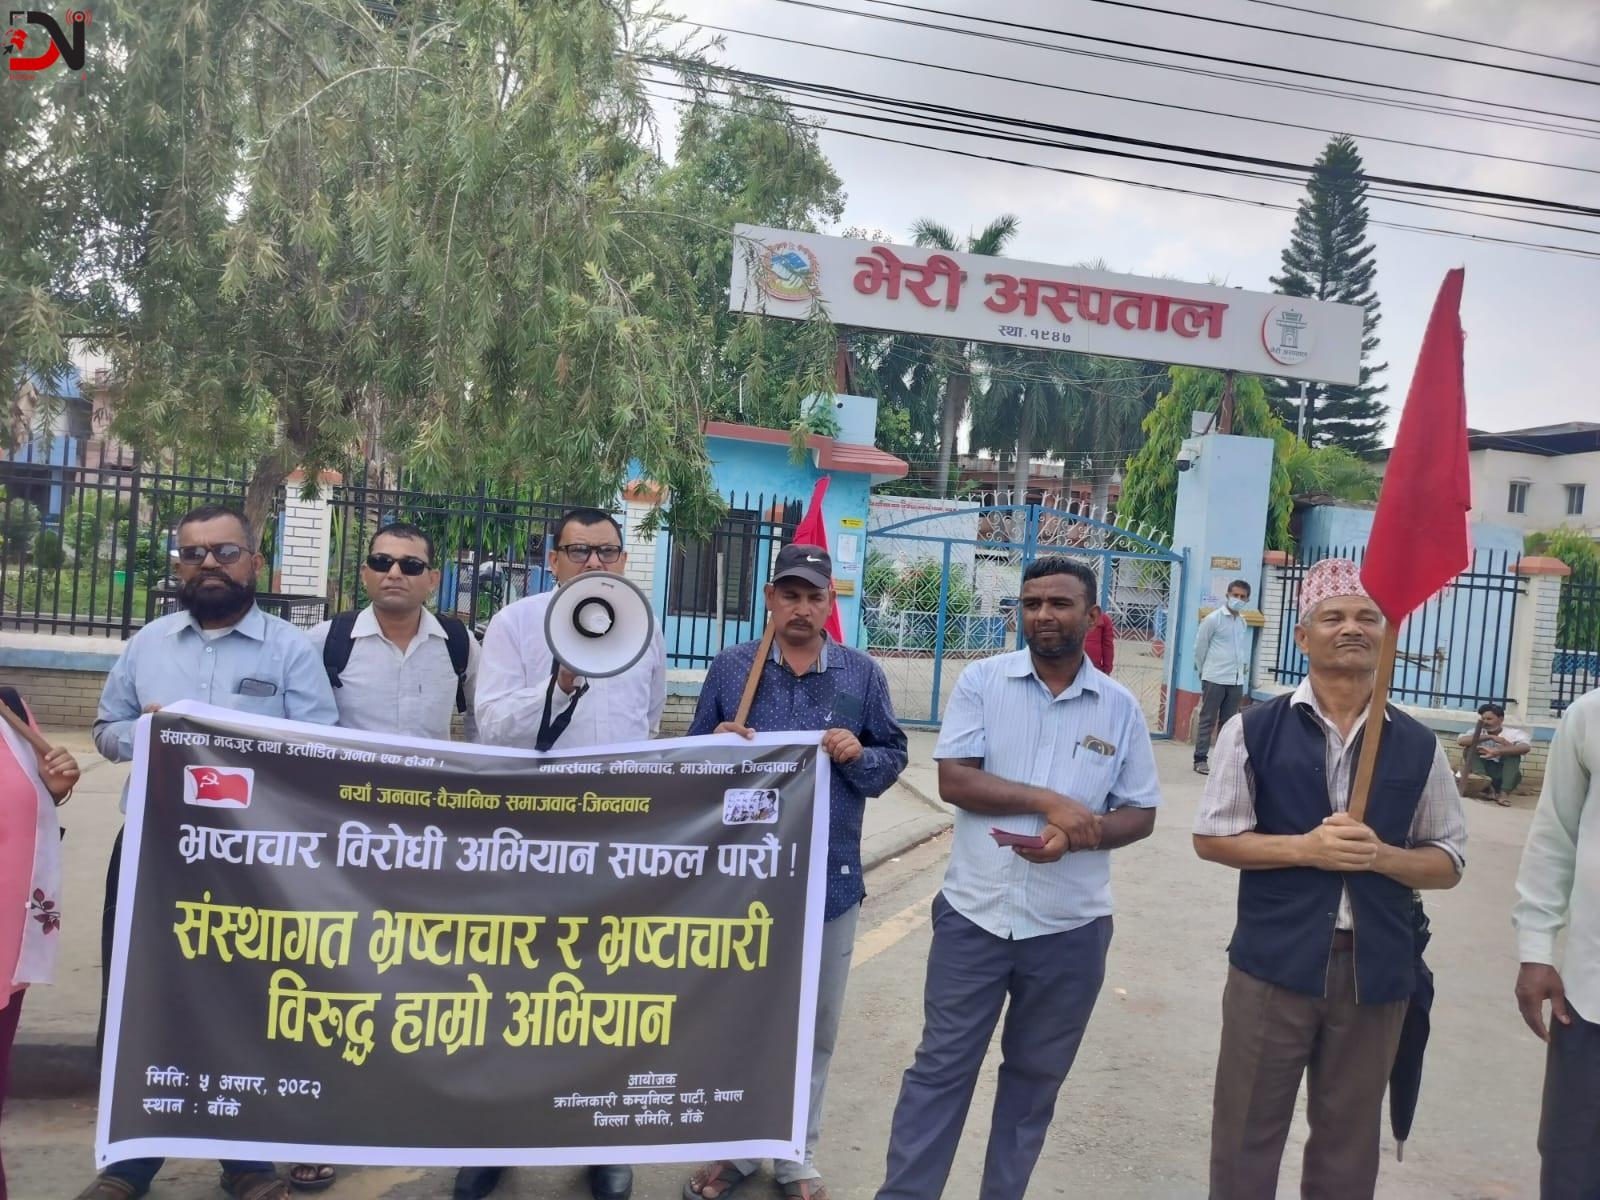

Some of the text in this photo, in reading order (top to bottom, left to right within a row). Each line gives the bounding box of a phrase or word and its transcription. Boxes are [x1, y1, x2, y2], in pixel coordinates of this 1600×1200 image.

[853, 246, 967, 312] भेरी
[984, 273, 1229, 339] अस्पताल
[160, 728, 210, 746] संसारका
[257, 740, 282, 754] तथा
[286, 742, 336, 760] उत्पीडित
[340, 750, 376, 763] जनता
[380, 754, 402, 765] एक
[339, 782, 372, 801] नयाँ
[178, 824, 327, 869] भ्रष्टाचार
[336, 821, 447, 871] विरोधी
[456, 827, 599, 874] अभियान
[608, 841, 708, 879] सफल
[717, 833, 783, 879] पारौं
[173, 890, 774, 975] संस्थागत भ्रष्टाचार र भ्रष्टाचारी
[391, 973, 493, 1055] हाम्रो
[503, 972, 677, 1046] अभियान
[199, 1074, 210, 1092] ५
[219, 1074, 267, 1095] असार,
[277, 1078, 321, 1099] २०८२
[627, 1071, 677, 1088] आयोजक
[143, 1098, 185, 1114] स्थान
[207, 1094, 241, 1117] बाँके
[553, 1091, 617, 1109] क्रान्तिकारी
[714, 1088, 744, 1103] नेपाल
[593, 1108, 704, 1127] जिल्ला समिति, बाँके
